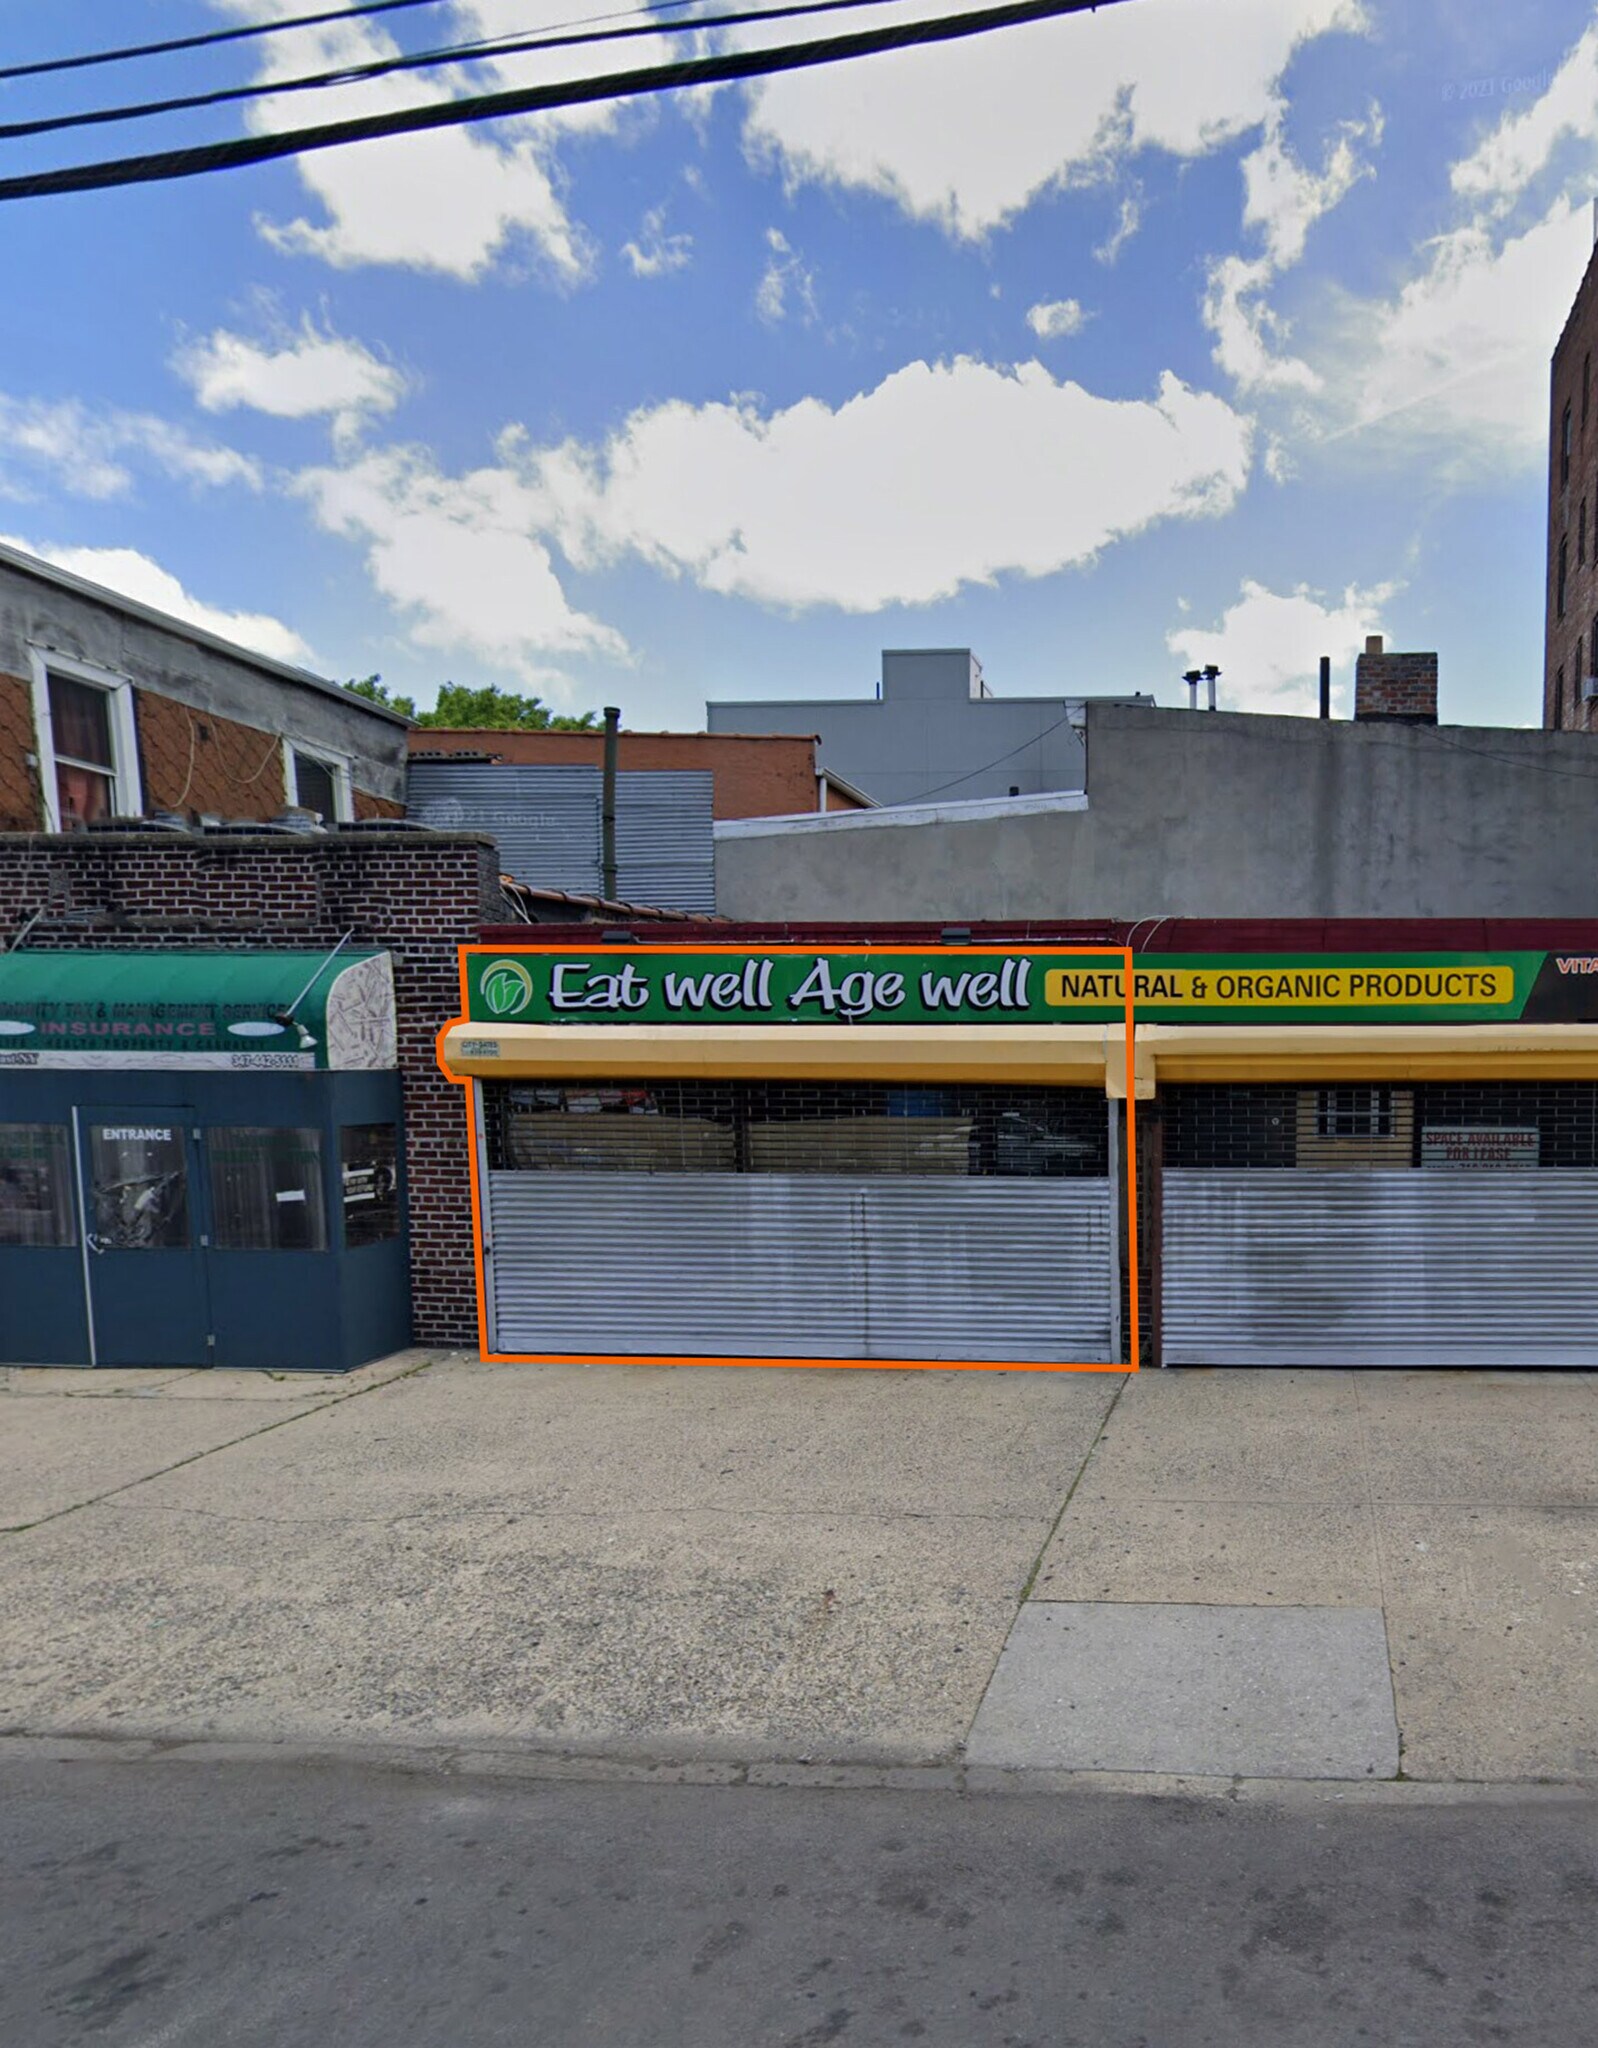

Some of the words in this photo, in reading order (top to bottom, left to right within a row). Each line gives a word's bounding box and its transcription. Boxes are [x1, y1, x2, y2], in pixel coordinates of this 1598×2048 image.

[549, 963, 649, 1008] Eat
[664, 959, 774, 1007] well
[789, 957, 906, 1016] Age
[921, 957, 1032, 1007] well
[1061, 974, 1183, 998] NATURAL
[1191, 976, 1208, 998] &
[1216, 974, 1340, 999] ORGANIC
[1350, 973, 1496, 997] PRODUCTS
[41, 1022, 216, 1035] INSURANCE
[103, 1128, 172, 1141] ENTRANCE
